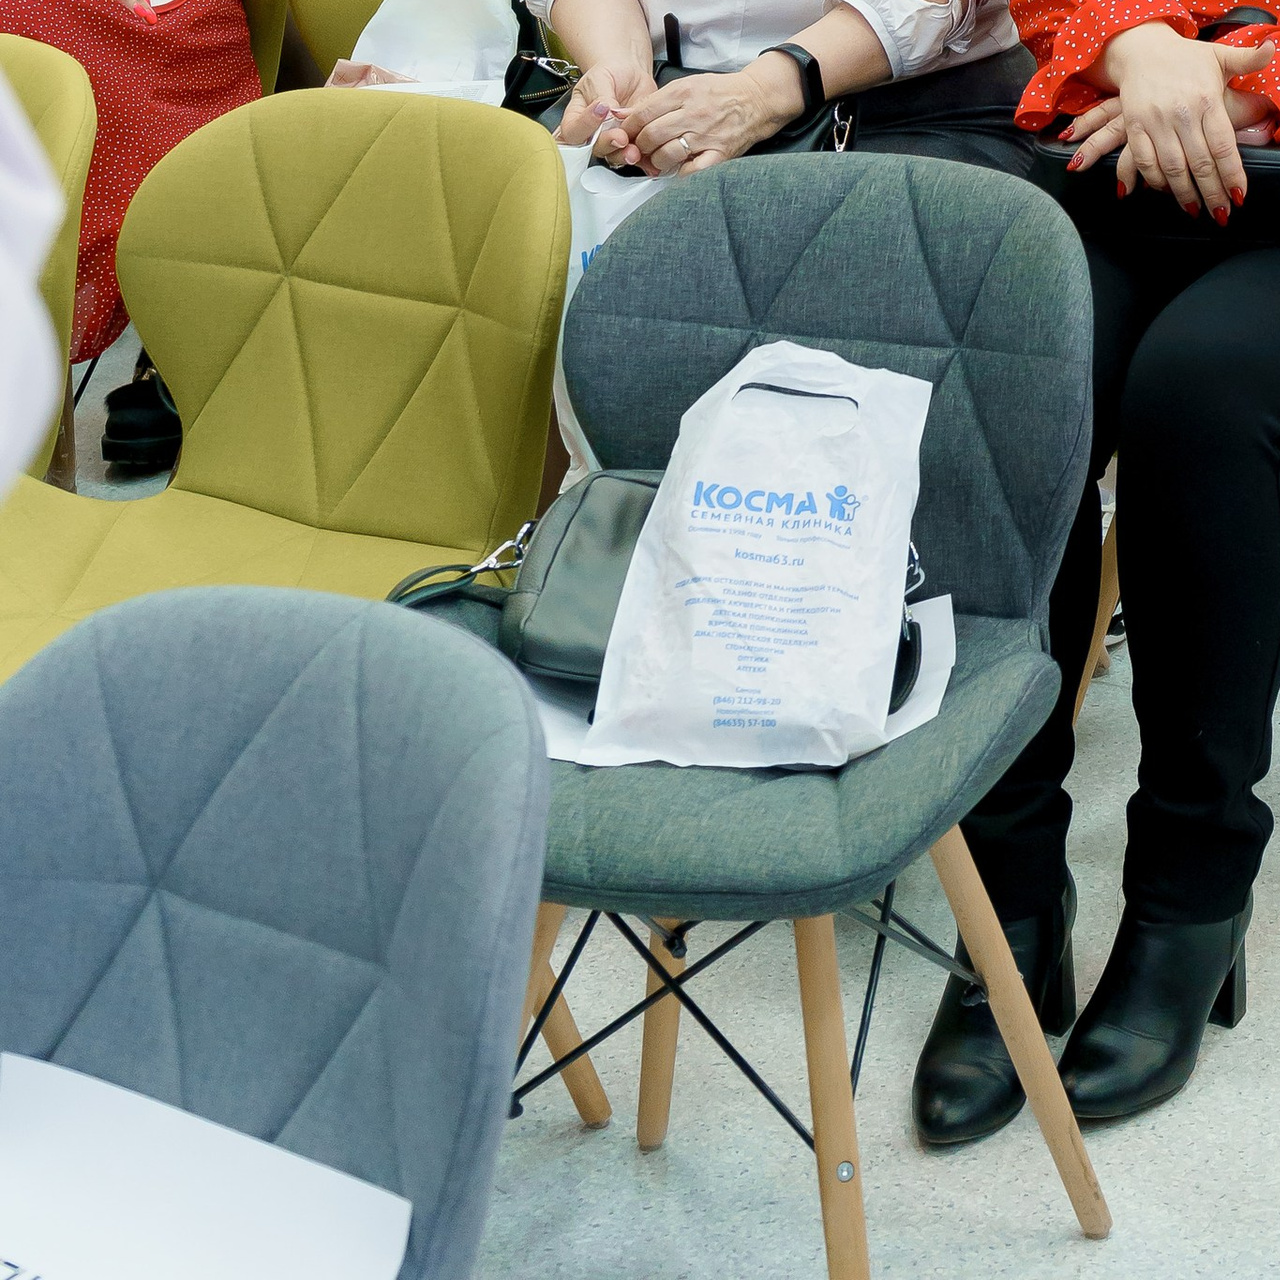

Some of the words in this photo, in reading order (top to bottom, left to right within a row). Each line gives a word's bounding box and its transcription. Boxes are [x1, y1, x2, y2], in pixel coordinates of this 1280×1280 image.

[693, 481, 818, 516] КОСМА
[690, 509, 775, 529] СЕМЕЙНАЯ
[781, 518, 853, 537] КЛИНИКА
[734, 547, 805, 567] kosma63.ru
[735, 664, 767, 673] АПТЕКА
[737, 654, 770, 664] ОПТИКА
